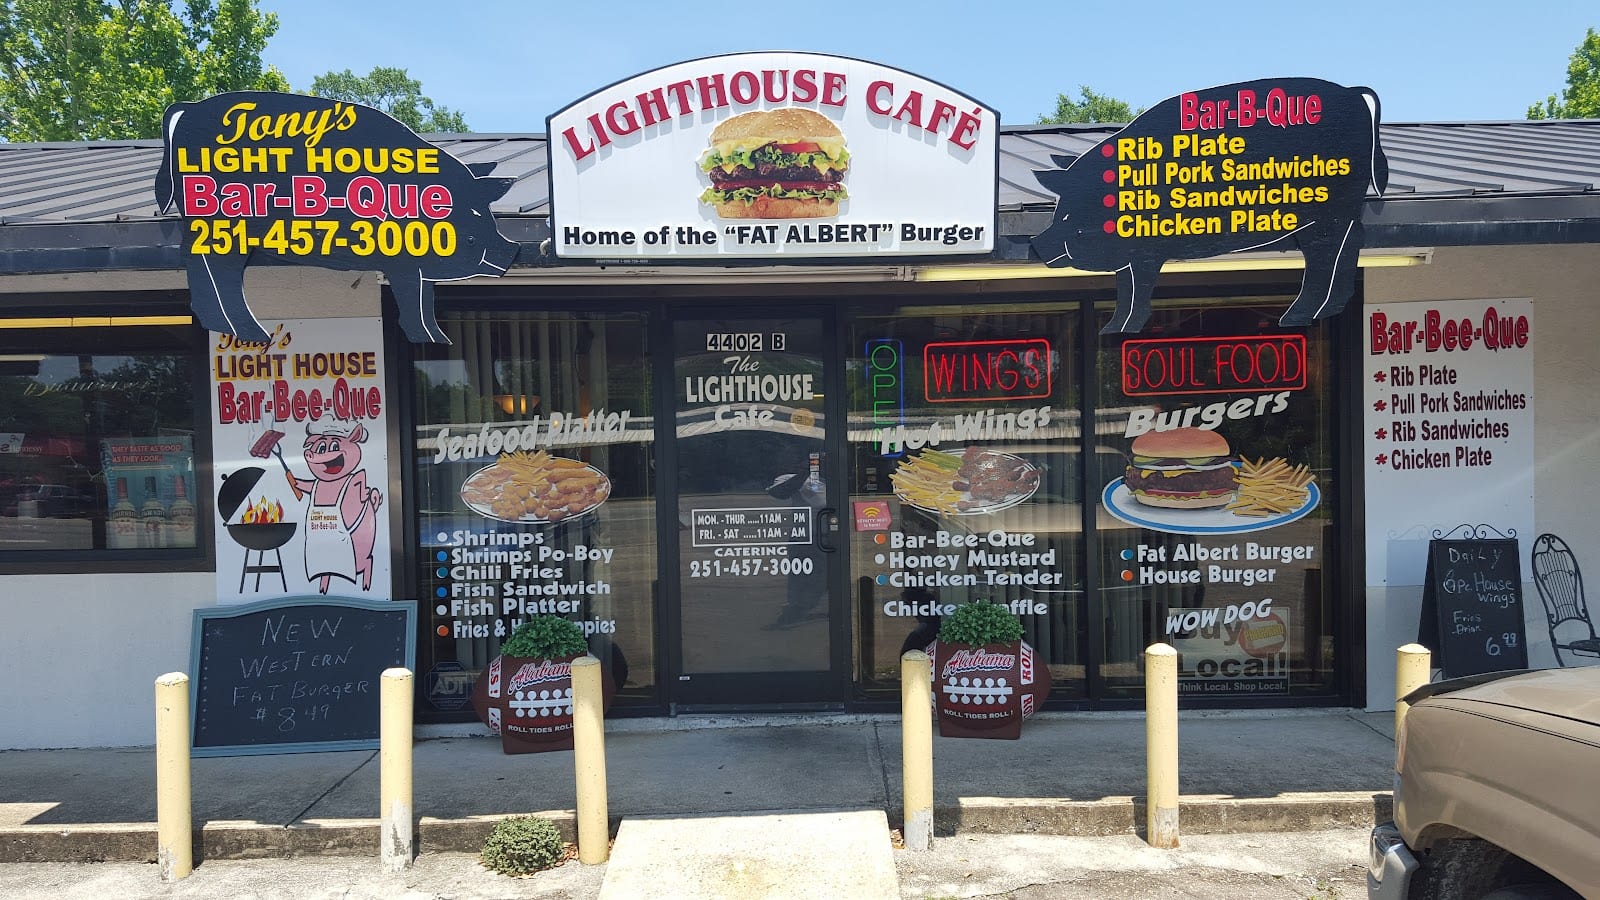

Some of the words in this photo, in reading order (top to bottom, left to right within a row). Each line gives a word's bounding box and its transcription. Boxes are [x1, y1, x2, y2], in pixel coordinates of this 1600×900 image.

[562, 69, 847, 161] LIGHTHOUSE
[865, 79, 982, 152] CAFÉ
[1180, 88, 1323, 130] Bar-B-Que
[216, 102, 357, 148] Tony's
[1117, 137, 1163, 161] Rib
[1172, 132, 1246, 158] Plate
[177, 147, 293, 173] LIGHT
[307, 147, 440, 173] HOUSE
[1118, 163, 1158, 187] Pull
[1165, 159, 1215, 185] Pork
[1221, 154, 1351, 181] Sandwiches
[183, 175, 453, 221] Bar-B-Que
[1118, 188, 1161, 212] Rib
[1170, 183, 1329, 208] Sandwiches
[564, 226, 636, 246] Home
[643, 225, 671, 246] of
[676, 226, 718, 246] the
[725, 225, 782, 245] “FAT
[786, 223, 894, 244] ALBERT”
[901, 223, 984, 246] Burger
[1116, 214, 1222, 238] Chicken
[1230, 209, 1298, 233] Plate
[190, 219, 457, 257] 251-457-3000
[707, 333, 762, 351] 4402
[772, 333, 785, 350] B
[1370, 306, 1529, 354] Bar-Bee-Que
[215, 354, 287, 380] LIGHT
[292, 352, 377, 380] HOUSE
[724, 355, 760, 374] The
[931, 348, 1041, 393] WINGS
[1125, 347, 1206, 390] SOUL
[1215, 341, 1302, 385] FOOD
[1390, 366, 1415, 387] Rib
[1419, 364, 1457, 386] Plate
[686, 374, 814, 403] LIGHTHOUSE
[218, 378, 382, 424] Bar-Bee-Que
[1391, 393, 1415, 415] Pull
[1420, 391, 1449, 413] Pork
[1453, 389, 1527, 412] Sandwiches
[714, 405, 778, 428] Café
[1125, 391, 1291, 438] Burgers
[434, 415, 541, 464] Seafood
[546, 408, 631, 447] Platter
[880, 421, 943, 455] Hot
[954, 405, 1051, 442] Wings
[1392, 421, 1417, 442] Rib
[1421, 418, 1509, 441] Sandwiches
[1391, 449, 1450, 470] Chicken
[1455, 446, 1492, 467] Plate
[697, 514, 719, 525] MON.
[725, 514, 746, 525] THUR
[793, 513, 806, 523] PM
[452, 530, 544, 548] Shrimps
[699, 529, 715, 539] FRI.
[724, 529, 739, 539] SAT
[791, 527, 806, 538] AM
[890, 530, 1035, 549] Bar-Bee-Que
[451, 548, 532, 565] Shrimps
[538, 545, 614, 564] Po-Boy
[714, 546, 788, 557] CATERING
[889, 551, 960, 570] Honey
[967, 549, 1056, 568] Mustard
[1138, 545, 1166, 563] Fat
[1173, 543, 1239, 562] Albert
[1246, 543, 1314, 565] Burger
[450, 565, 502, 580] Chili
[510, 564, 563, 579] Fries
[690, 557, 813, 578] 251-457-3000
[889, 571, 977, 587] Chicken
[984, 569, 1063, 585] Tender
[1139, 567, 1200, 584] House
[1208, 565, 1276, 586] Burger
[451, 582, 495, 598] Fish
[503, 580, 611, 596] Sandwich
[451, 599, 494, 616] Fish
[503, 597, 581, 615] Platter
[883, 600, 966, 617] Chicke
[976, 598, 1048, 616] ffle
[1166, 607, 1219, 634] WOW
[1224, 598, 1273, 624] DOG
[261, 615, 343, 646] NEW
[453, 620, 489, 639] Fries
[494, 618, 506, 637] &
[240, 646, 353, 679] WESTERN
[942, 649, 1015, 679] Alabama
[1177, 653, 1287, 677] Local!
[431, 676, 466, 695] ADT
[508, 660, 572, 695] Alabam
[1177, 683, 1201, 692] Think
[1204, 683, 1231, 691] Local.
[1234, 682, 1256, 692] Shop
[1258, 682, 1286, 690] Local.
[233, 684, 283, 706] FAT
